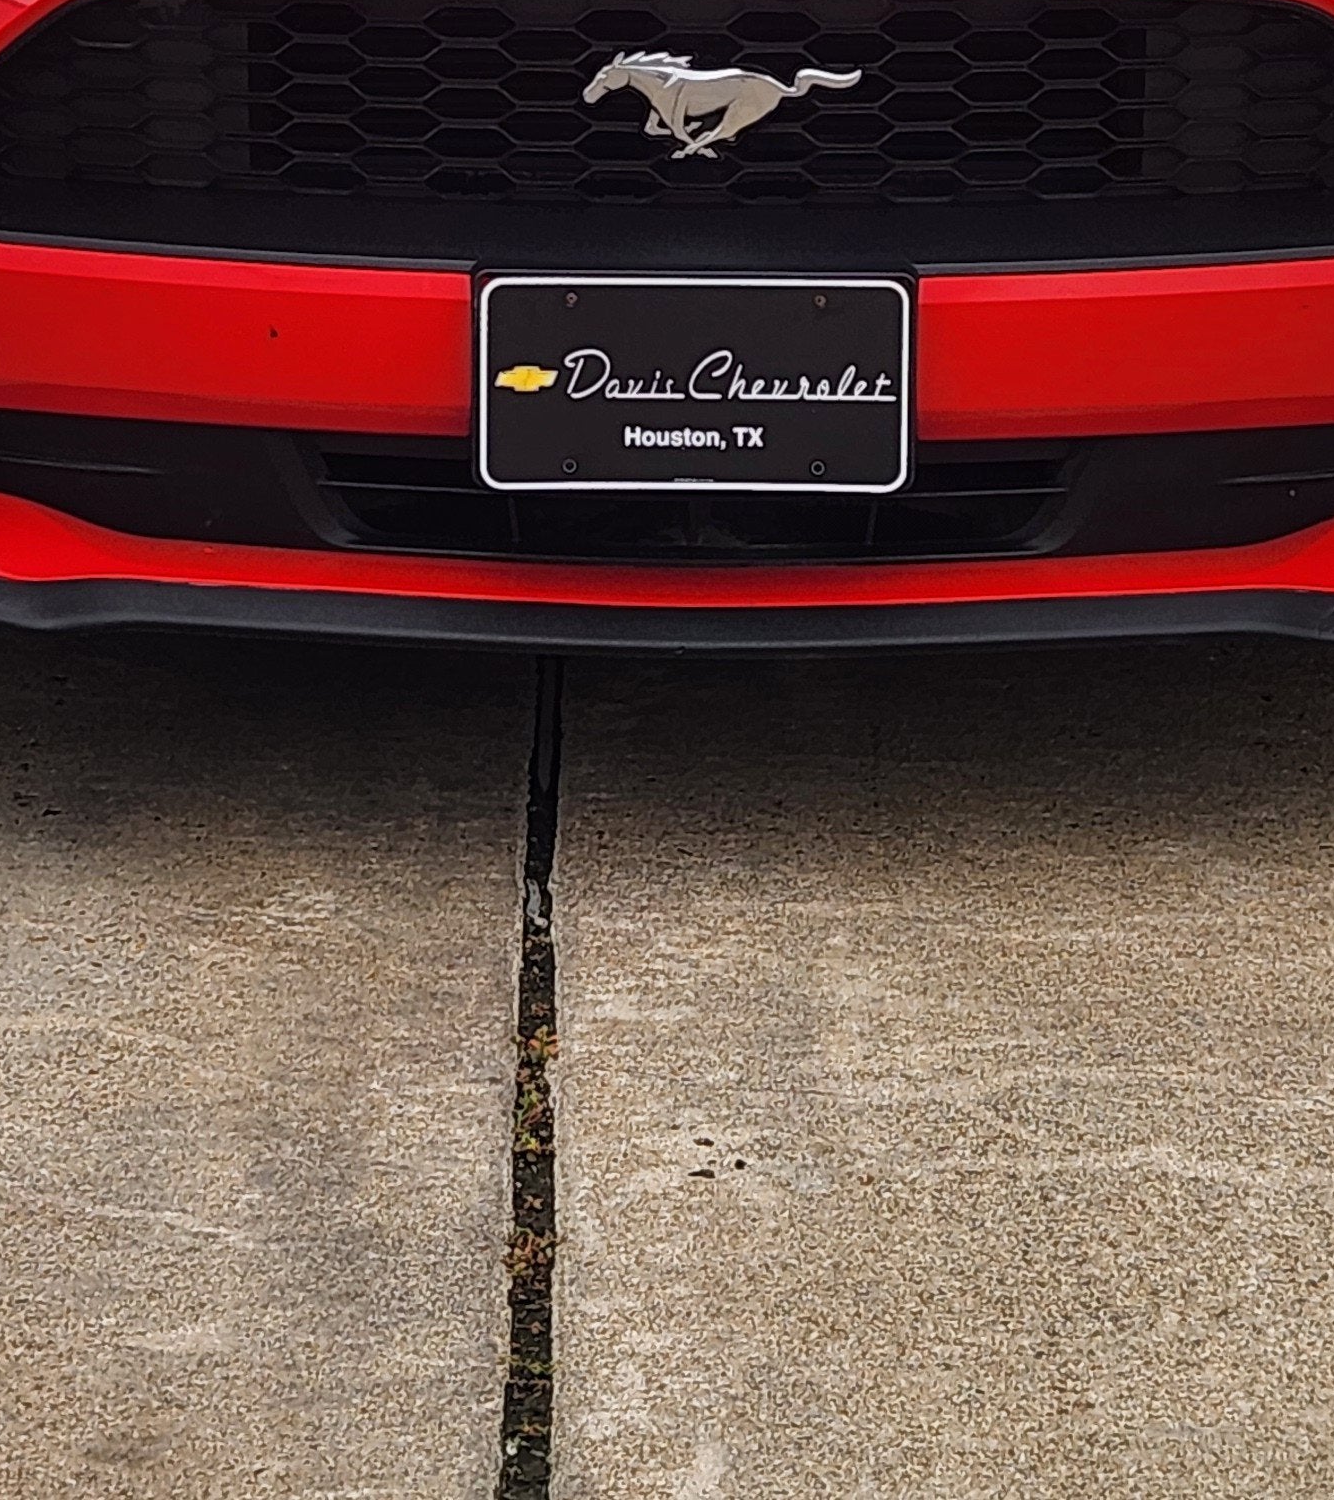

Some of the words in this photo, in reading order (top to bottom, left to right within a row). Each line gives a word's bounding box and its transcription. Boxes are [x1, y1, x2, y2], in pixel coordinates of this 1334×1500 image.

[564, 349, 685, 399] Davis
[688, 350, 897, 401] Chevrolet
[623, 426, 727, 450] Houston,
[732, 426, 764, 448] TX
